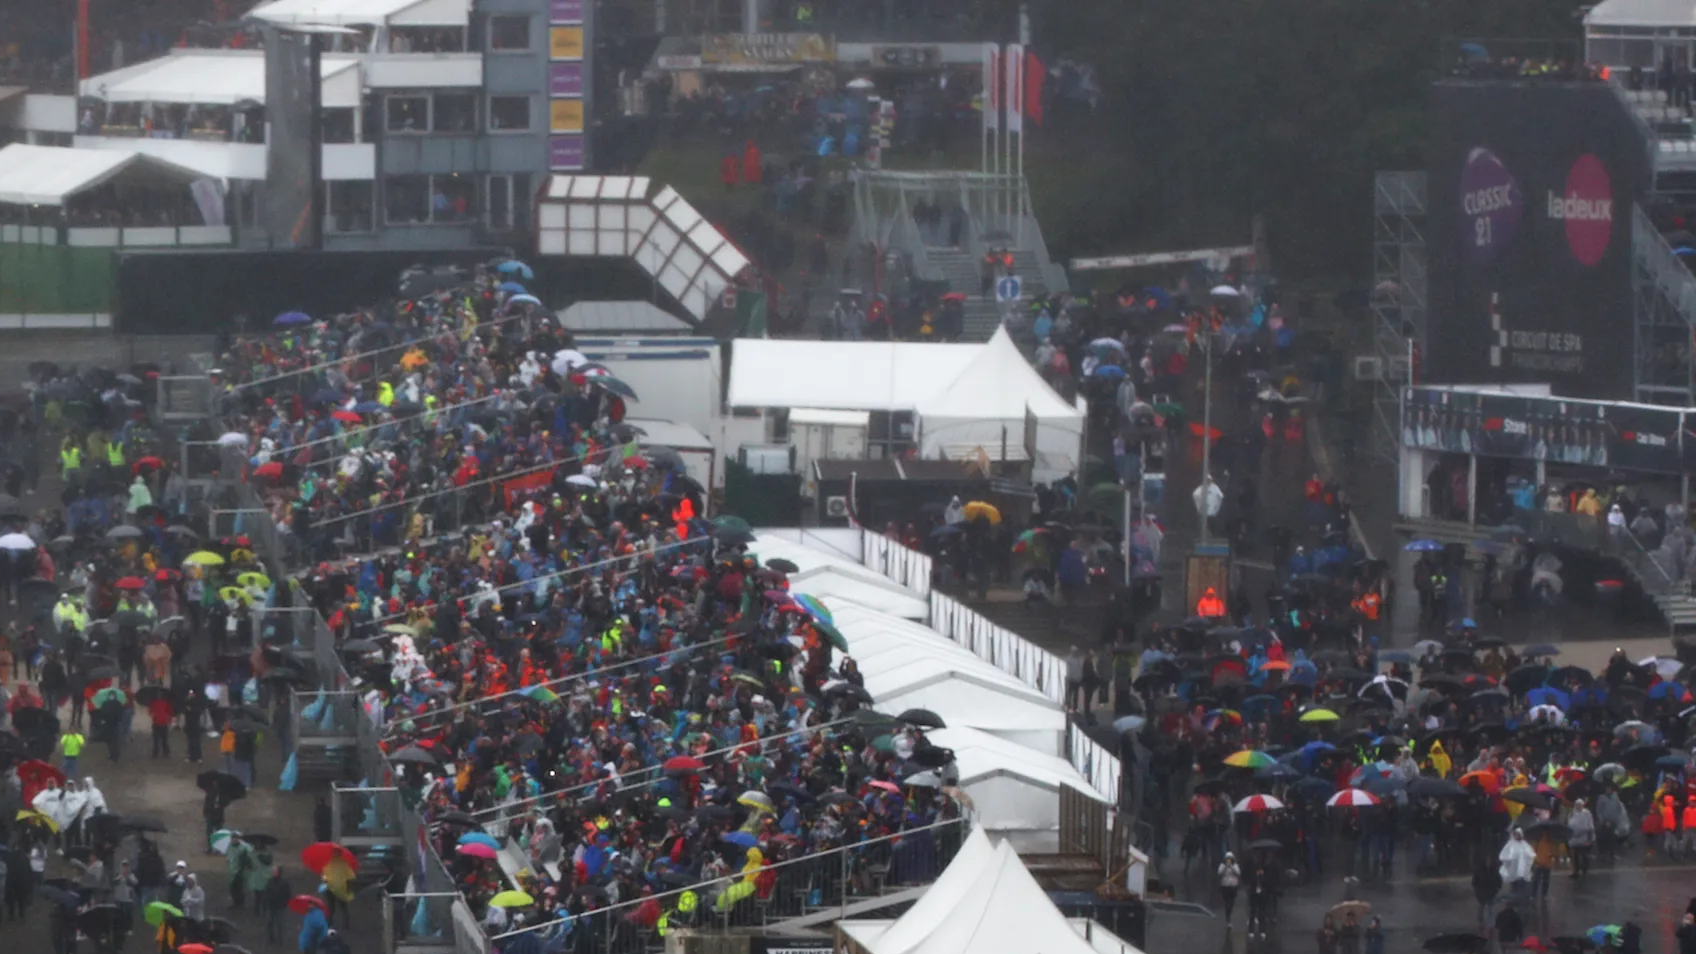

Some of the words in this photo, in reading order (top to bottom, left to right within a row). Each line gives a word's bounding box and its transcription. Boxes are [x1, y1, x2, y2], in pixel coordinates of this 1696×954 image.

[1463, 183, 1512, 216] CLASSIC
[1548, 189, 1612, 222] ladeux
[1475, 216, 1492, 246] 21
